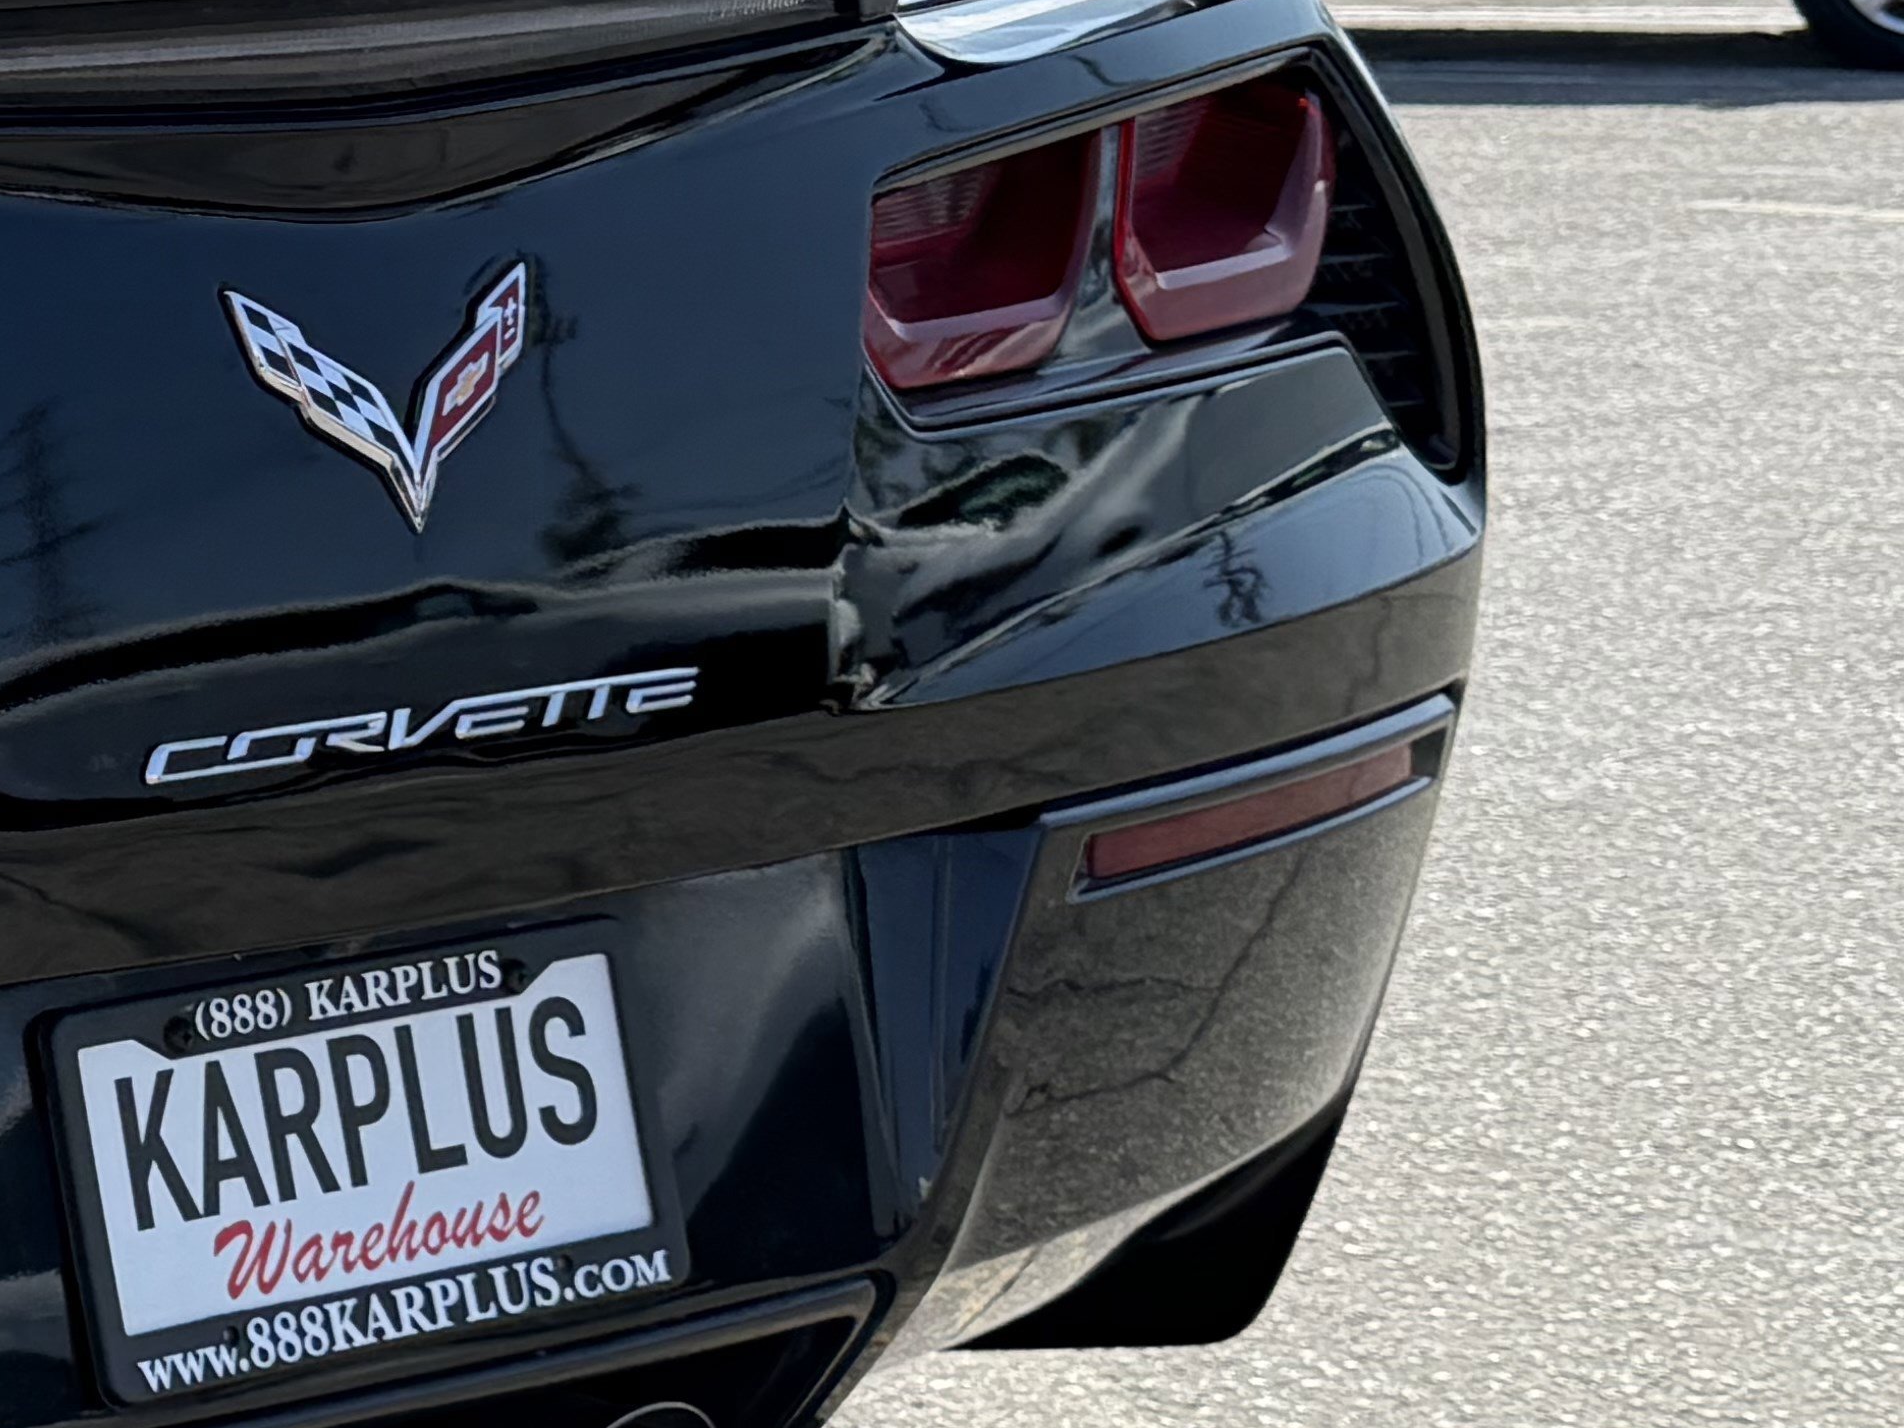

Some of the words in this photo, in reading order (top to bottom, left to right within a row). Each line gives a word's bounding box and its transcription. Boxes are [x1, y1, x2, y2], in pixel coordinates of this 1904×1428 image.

[145, 667, 698, 785] CORVETTE
[193, 987, 292, 1042] (888)
[306, 950, 503, 1021] KARPLUS
[114, 995, 598, 1232] KARPLUS
[213, 1180, 545, 1301] Warehouse
